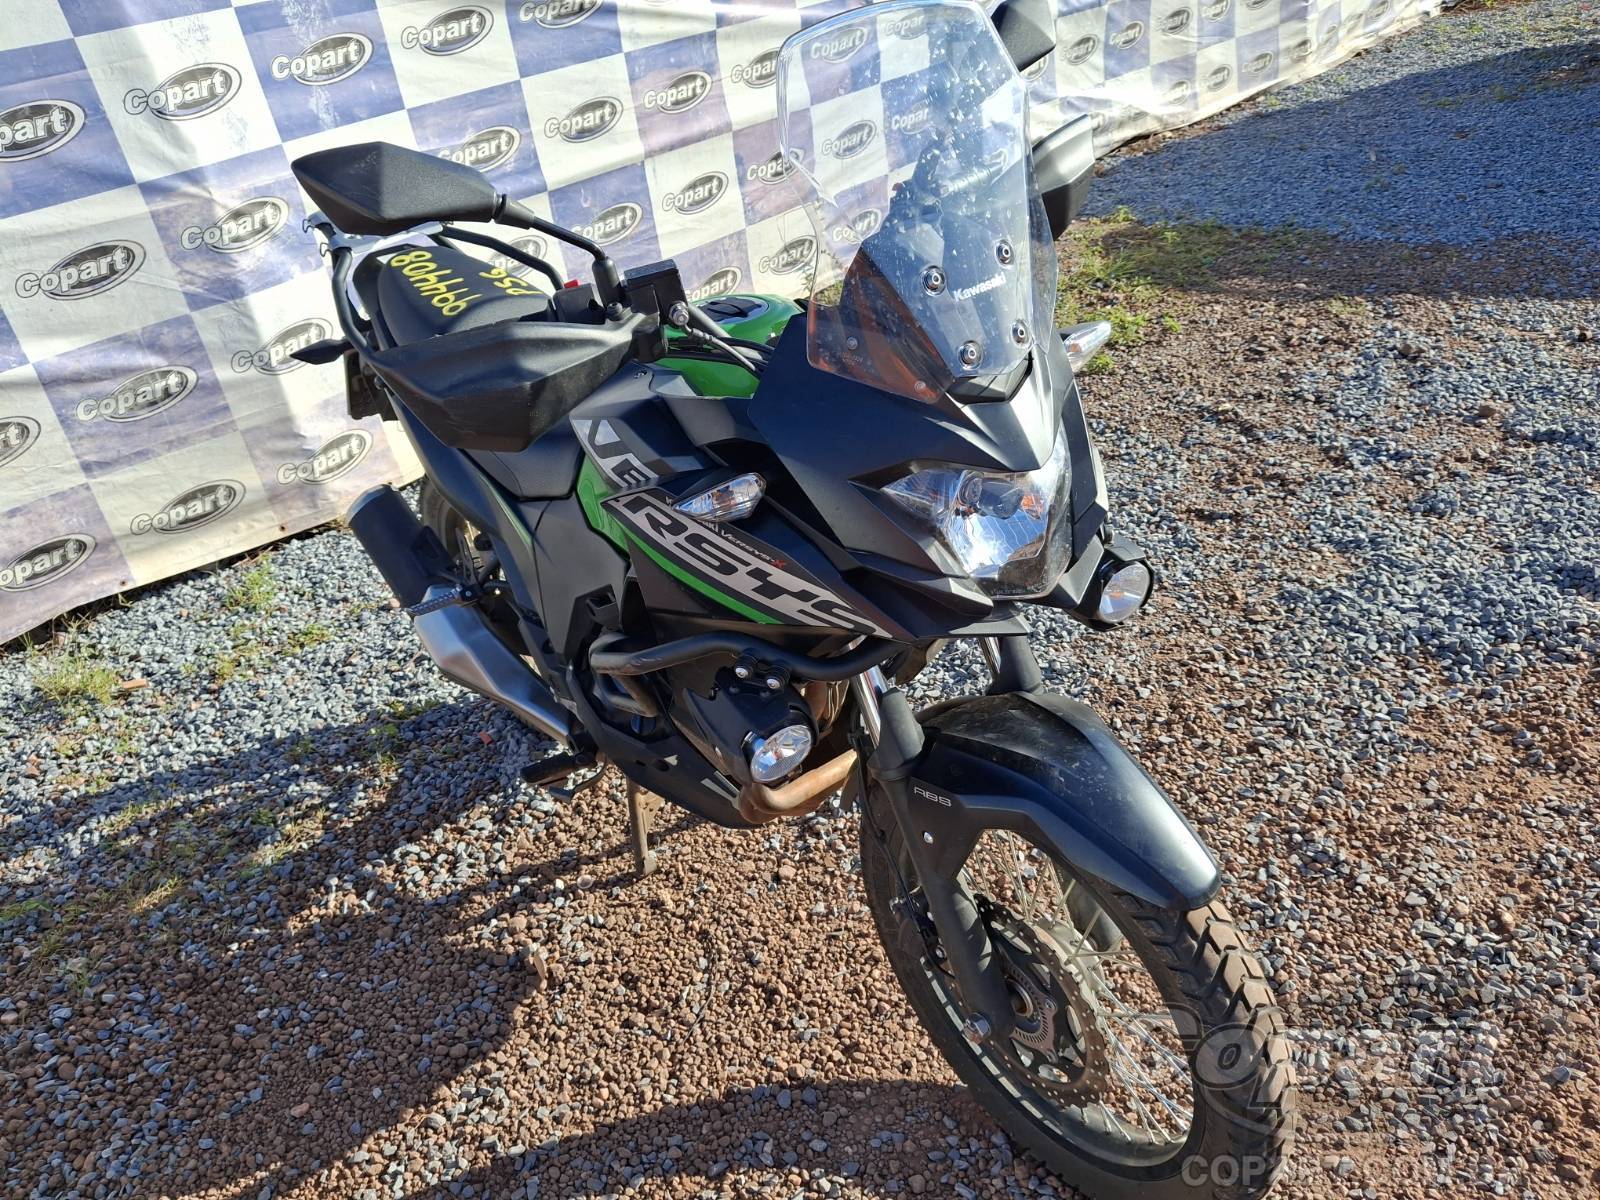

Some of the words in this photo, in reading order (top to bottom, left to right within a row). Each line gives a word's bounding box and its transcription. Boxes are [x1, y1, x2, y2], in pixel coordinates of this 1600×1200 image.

[402, 9, 481, 50] Copart
[811, 28, 861, 59] Copart
[886, 14, 924, 36] Copar
[272, 38, 361, 80] Copart
[731, 59, 776, 84] Copa
[124, 70, 227, 115] Copart
[643, 76, 706, 109] Copart
[0, 105, 67, 153] part
[544, 102, 615, 137] Copart
[891, 107, 929, 130] Copar
[823, 126, 870, 156] Copart
[746, 158, 784, 181] Copa
[662, 174, 721, 211] Copart
[180, 201, 278, 250] Copart
[15, 245, 129, 299] Copart
[758, 239, 810, 273] Copart
[954, 271, 1006, 301] Kawasaki
[76, 370, 183, 422] Copart
[276, 435, 362, 484] Copart
[130, 484, 232, 535] Copart
[0, 538, 81, 586] opart
